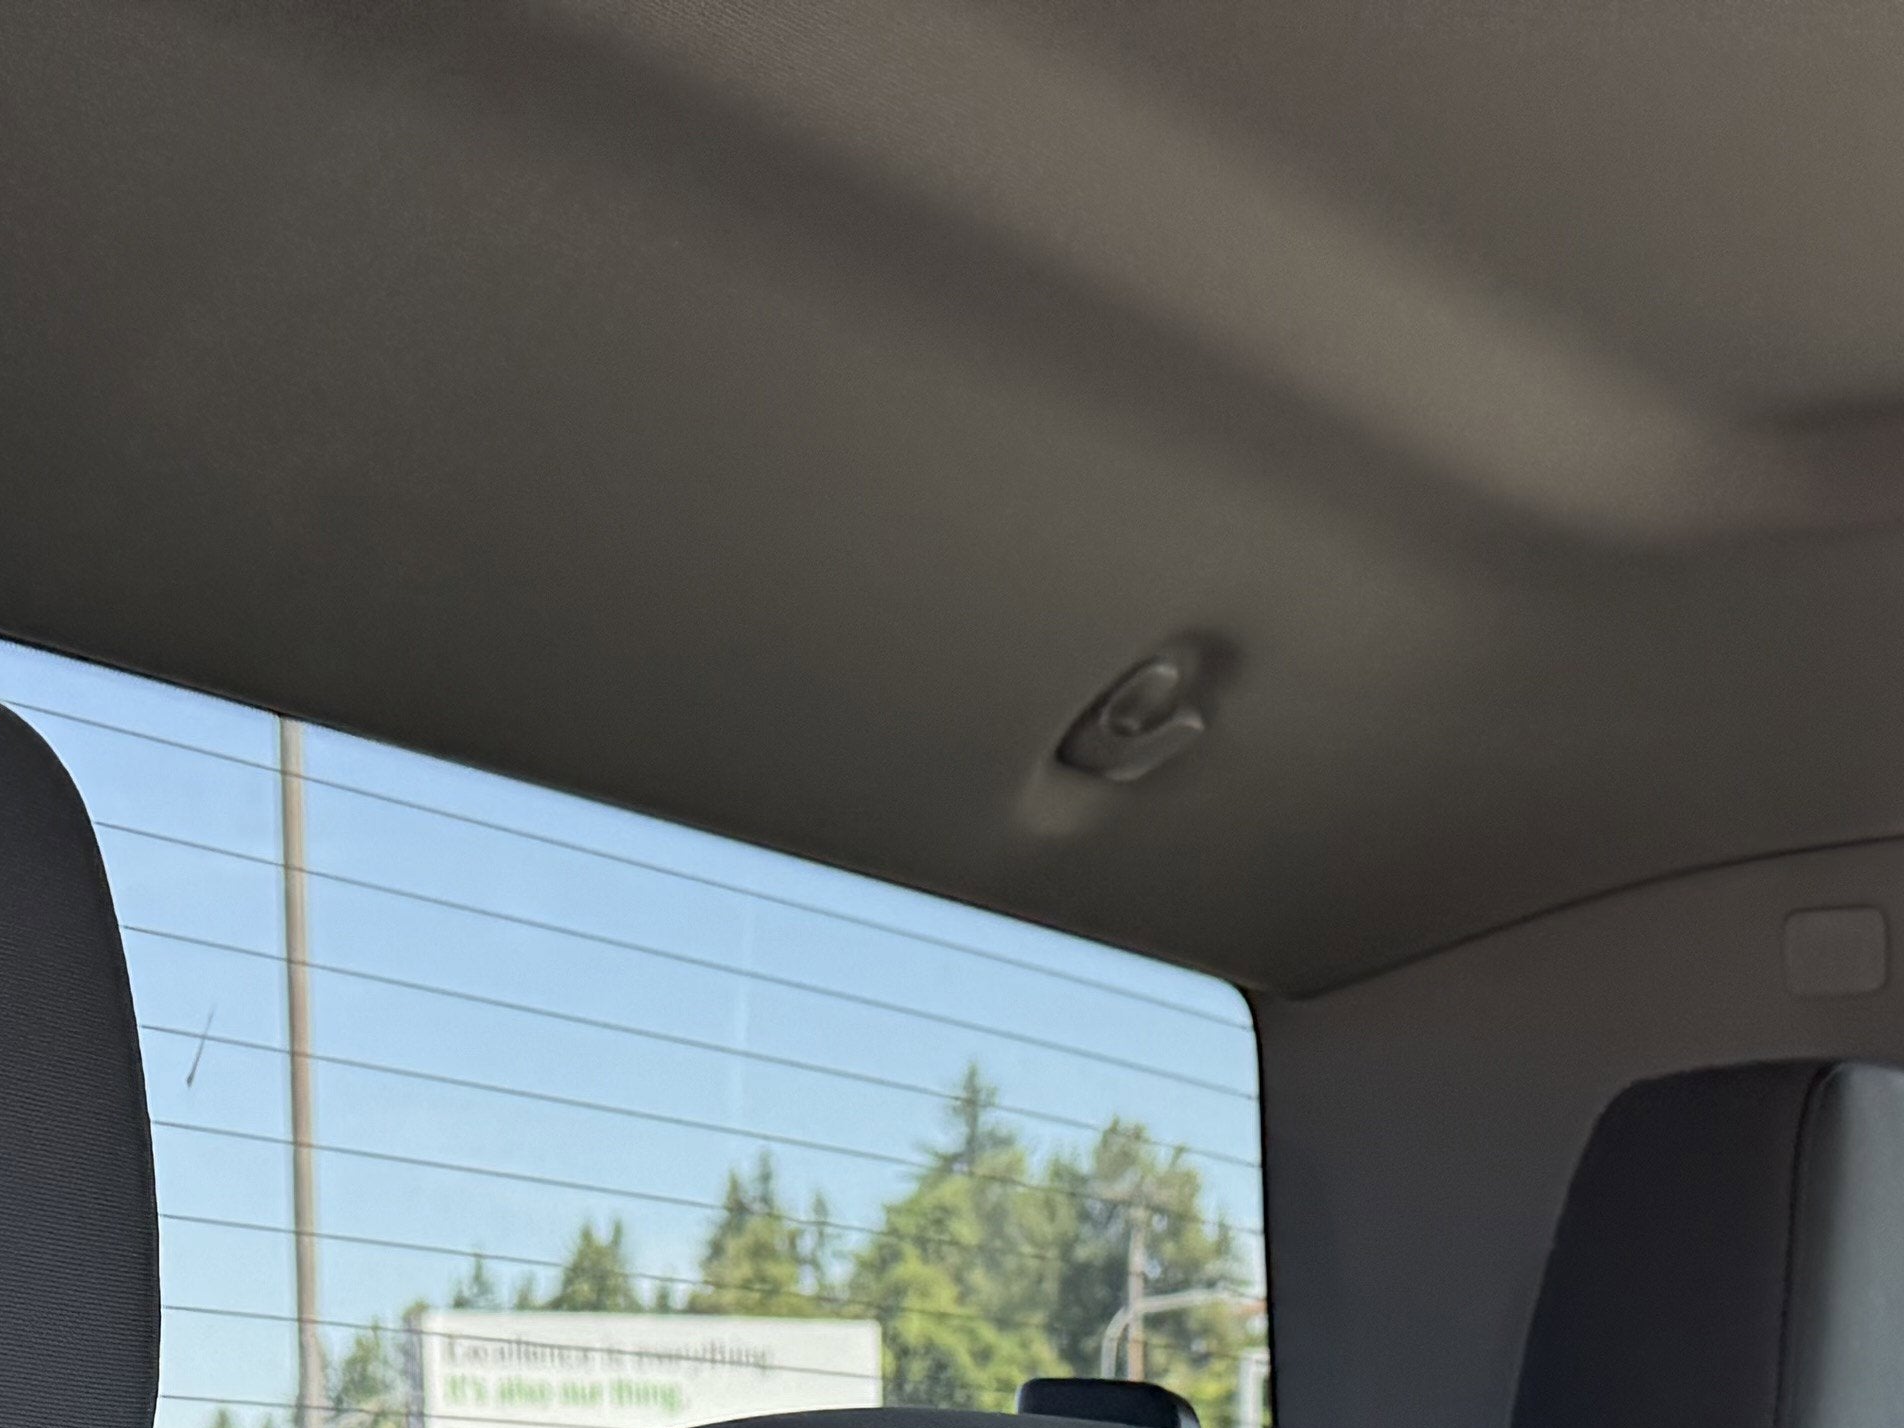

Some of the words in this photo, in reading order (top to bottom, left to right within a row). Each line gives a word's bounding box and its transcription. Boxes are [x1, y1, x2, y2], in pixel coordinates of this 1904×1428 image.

[446, 1374, 487, 1405] It's
[497, 1375, 553, 1407] also
[560, 1382, 603, 1408] our
